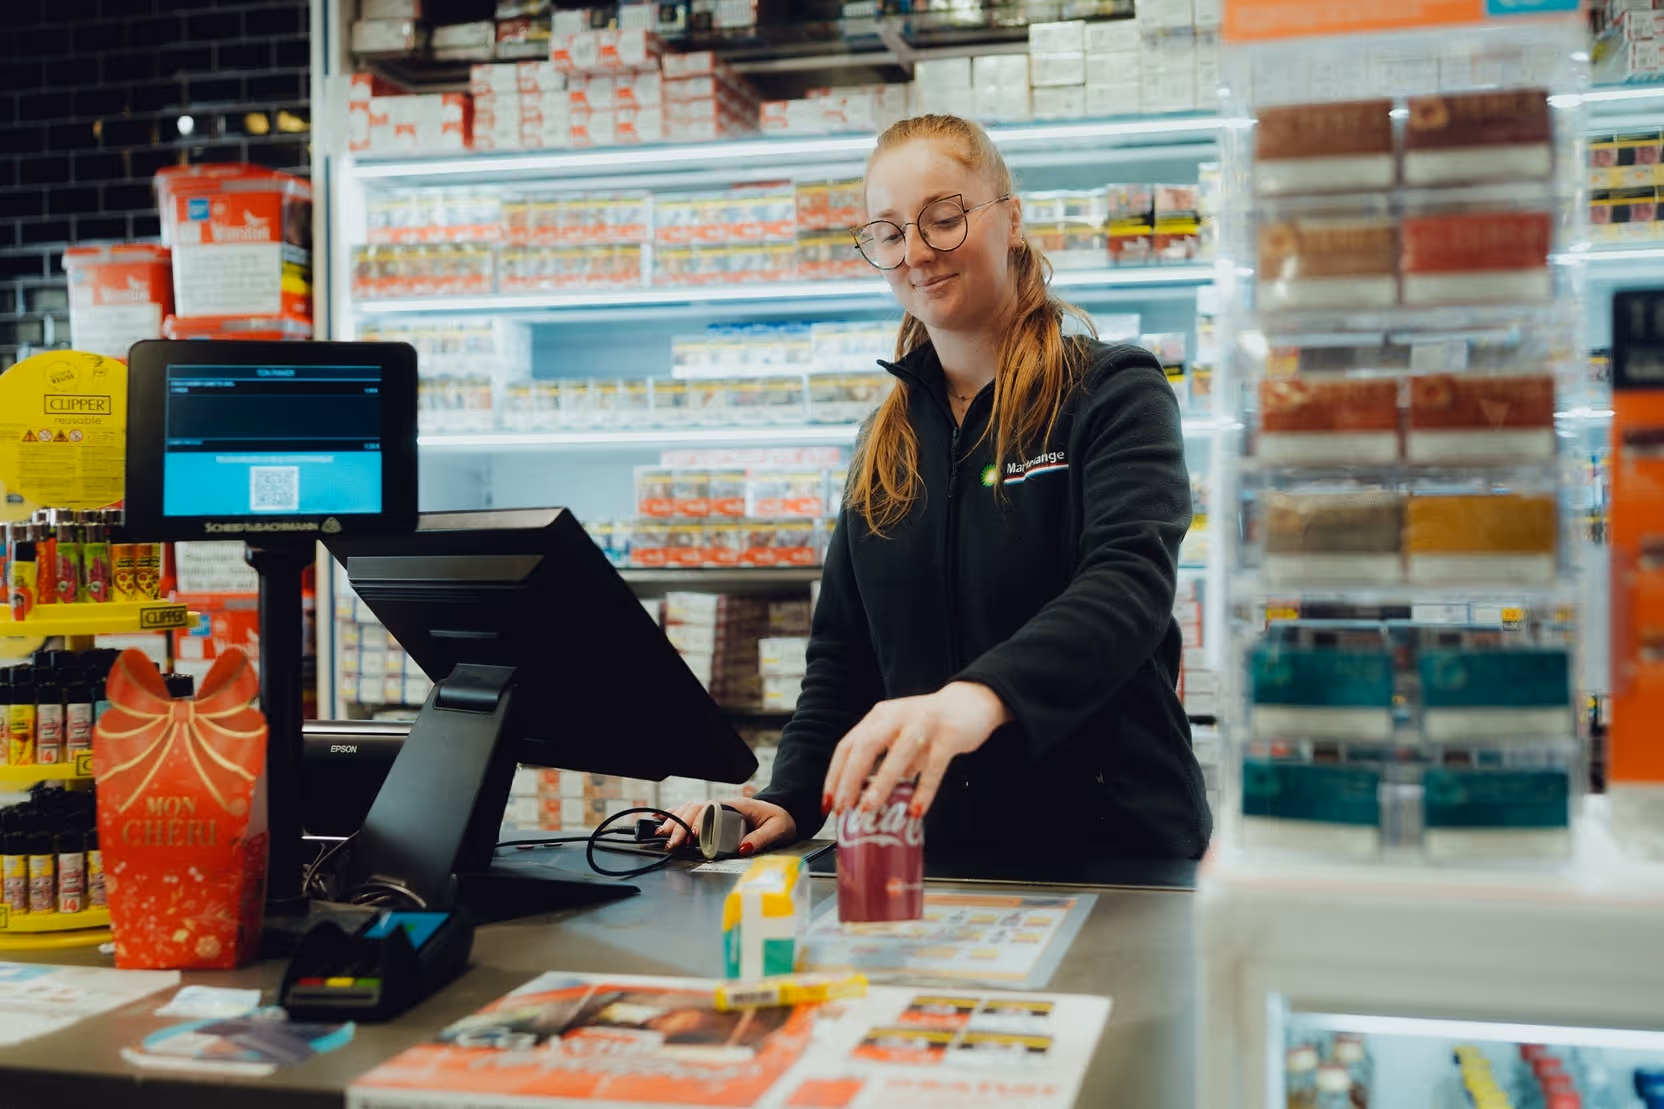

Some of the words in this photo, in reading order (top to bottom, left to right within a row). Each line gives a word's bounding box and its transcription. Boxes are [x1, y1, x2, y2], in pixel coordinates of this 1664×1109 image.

[50, 398, 105, 411] CLIPPER
[54, 416, 102, 425] reusable
[331, 744, 358, 754] EPSON
[146, 796, 196, 816] MON
